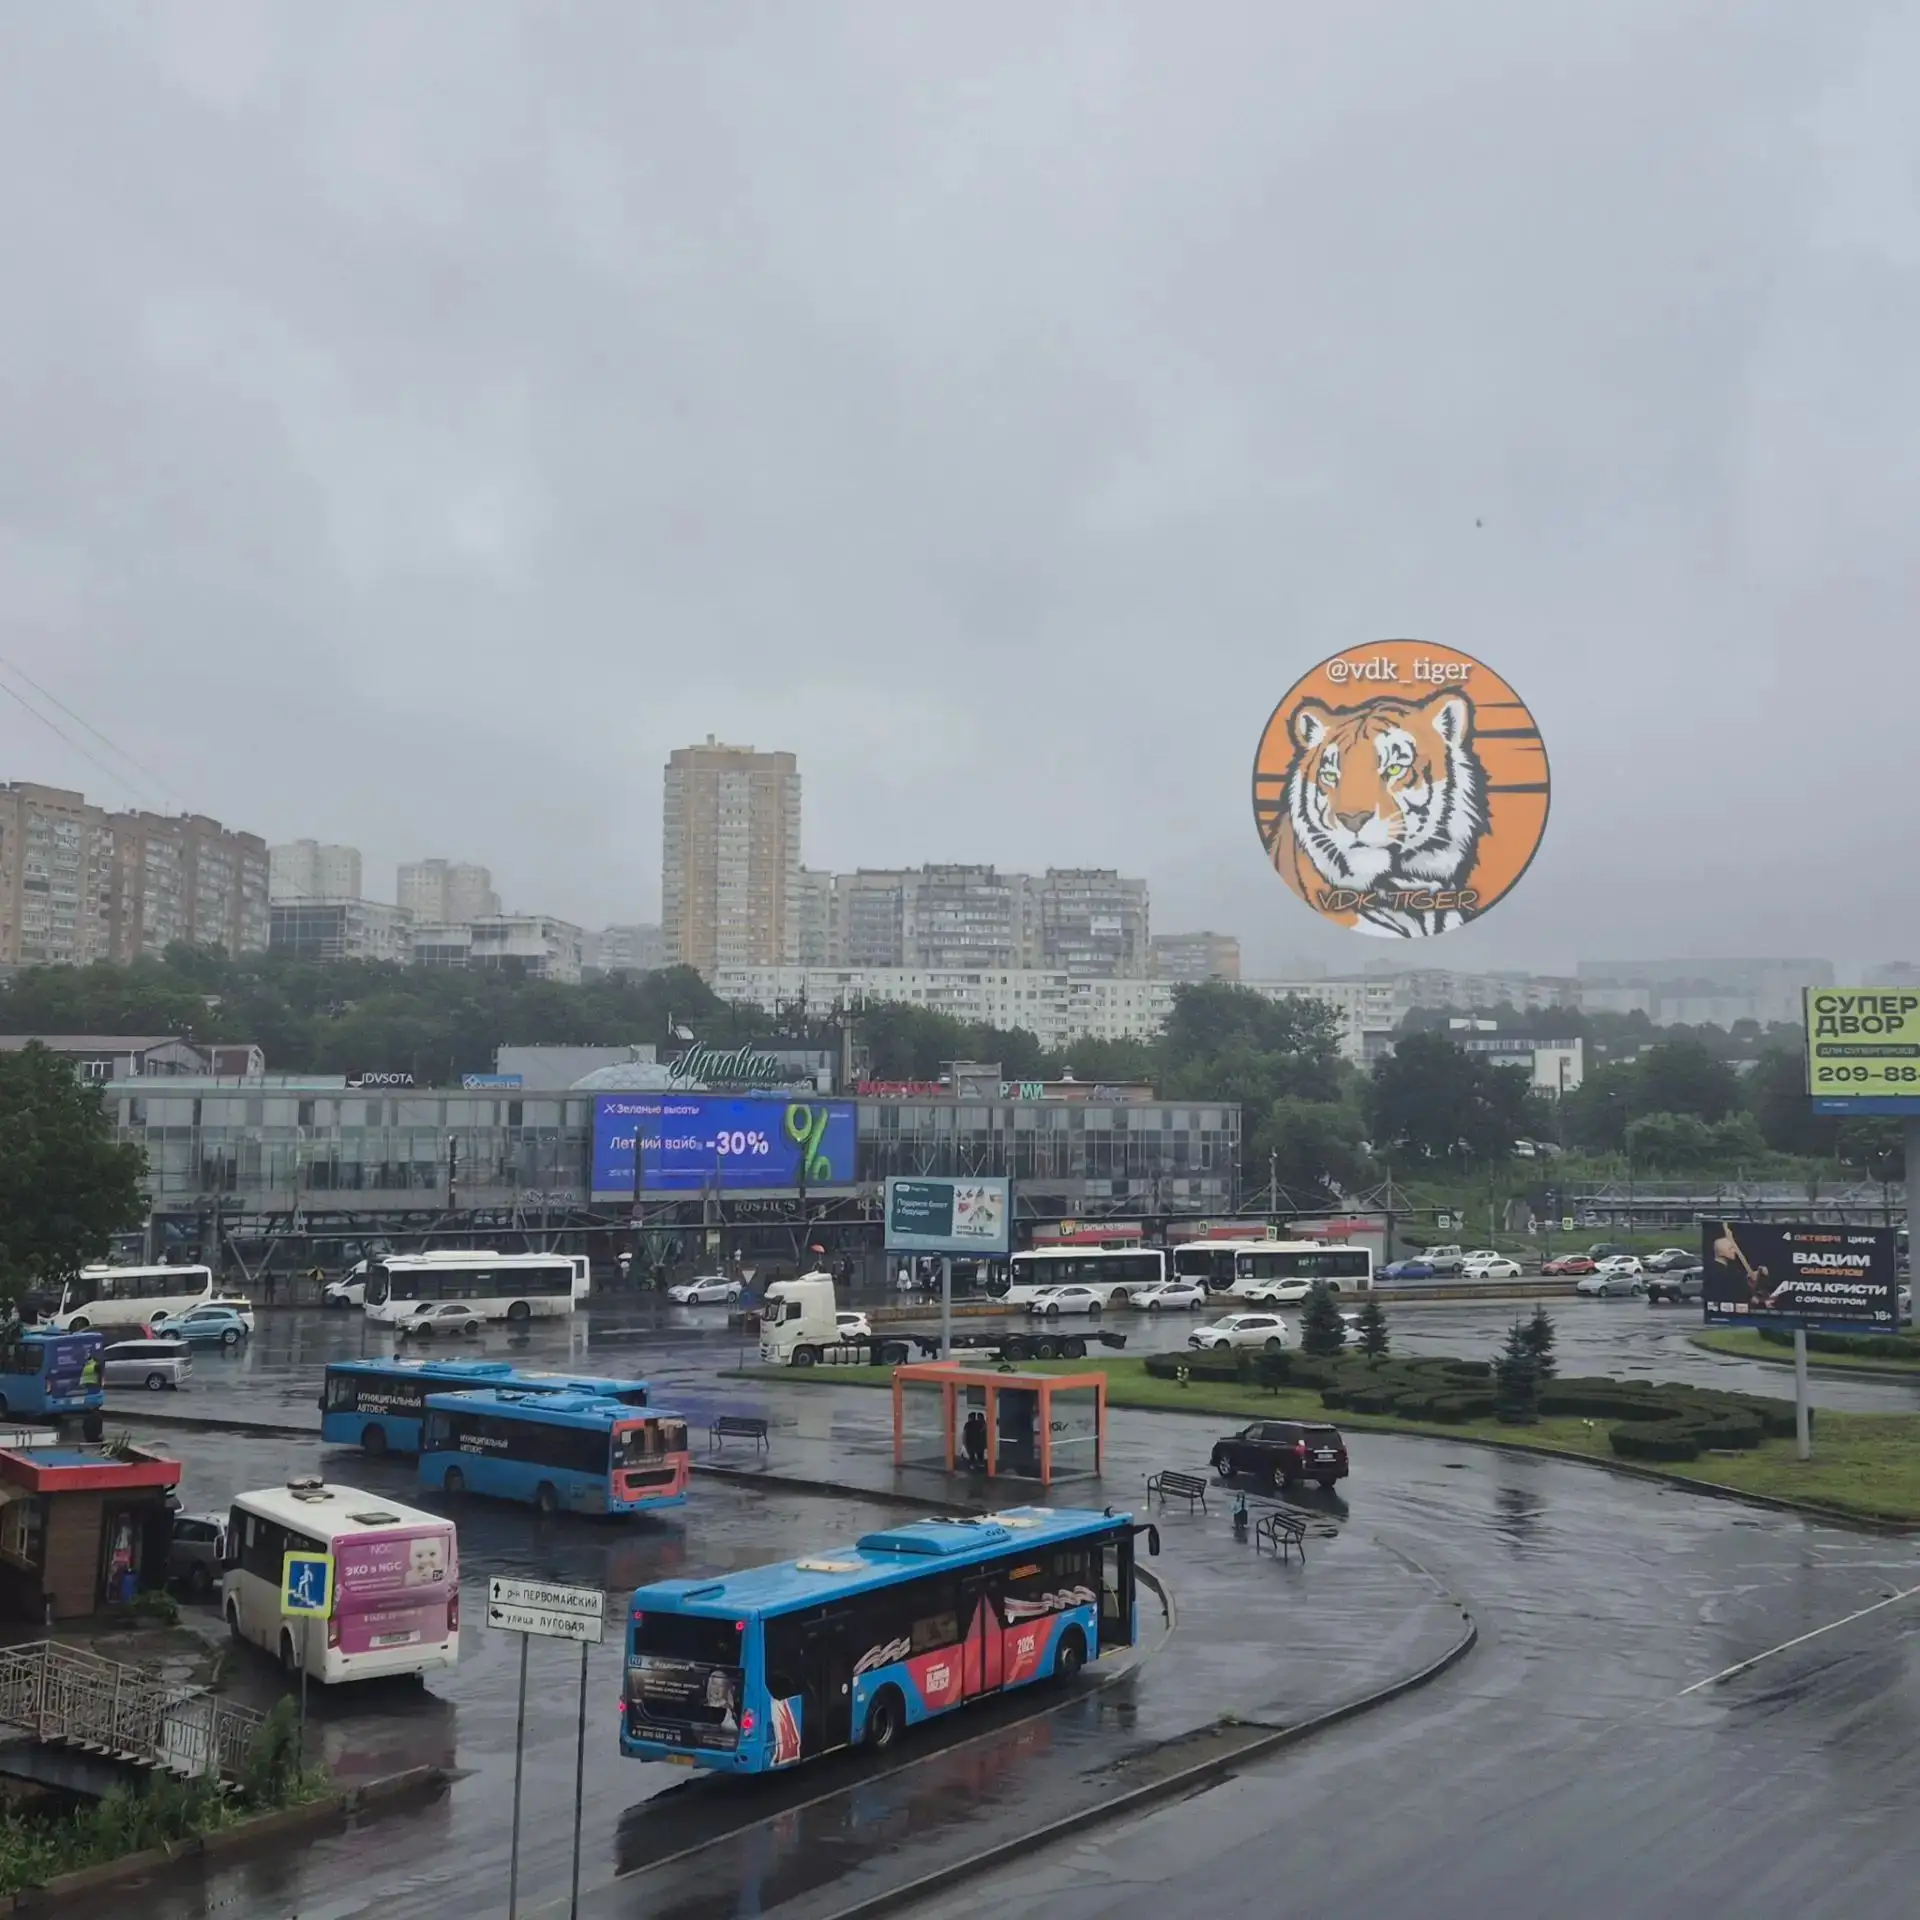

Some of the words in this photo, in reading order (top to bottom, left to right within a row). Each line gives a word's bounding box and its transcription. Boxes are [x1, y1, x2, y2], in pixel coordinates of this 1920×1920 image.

[1814, 995, 1918, 1015] СУПЕР
[1815, 1015, 1905, 1038] ДВОР
[1817, 1066, 1920, 1082] 209-88
[664, 1135, 697, 1150] вайб
[706, 1131, 769, 1156] -30%
[1782, 1231, 1792, 1241] 4
[1847, 1235, 1876, 1244] ЦИРК
[1792, 1252, 1871, 1268] ВАДИМ
[1770, 1280, 1823, 1298] АГАТА
[1824, 1282, 1888, 1296] КРИСТИ
[1804, 1296, 1868, 1306] ОРКЕСТРОМ
[356, 1392, 422, 1408] МУНИЦИПАЛЬНЫЙ
[356, 1403, 389, 1415] АВТОБУС
[345, 1564, 369, 1577] ЭКО
[378, 1560, 402, 1573] NGC
[506, 1589, 520, 1599] р-н
[523, 1589, 598, 1609] ПЕРВОМАЙСКИЙ
[506, 1615, 534, 1625] улица
[540, 1616, 585, 1632] ЛУГОВАЯ
